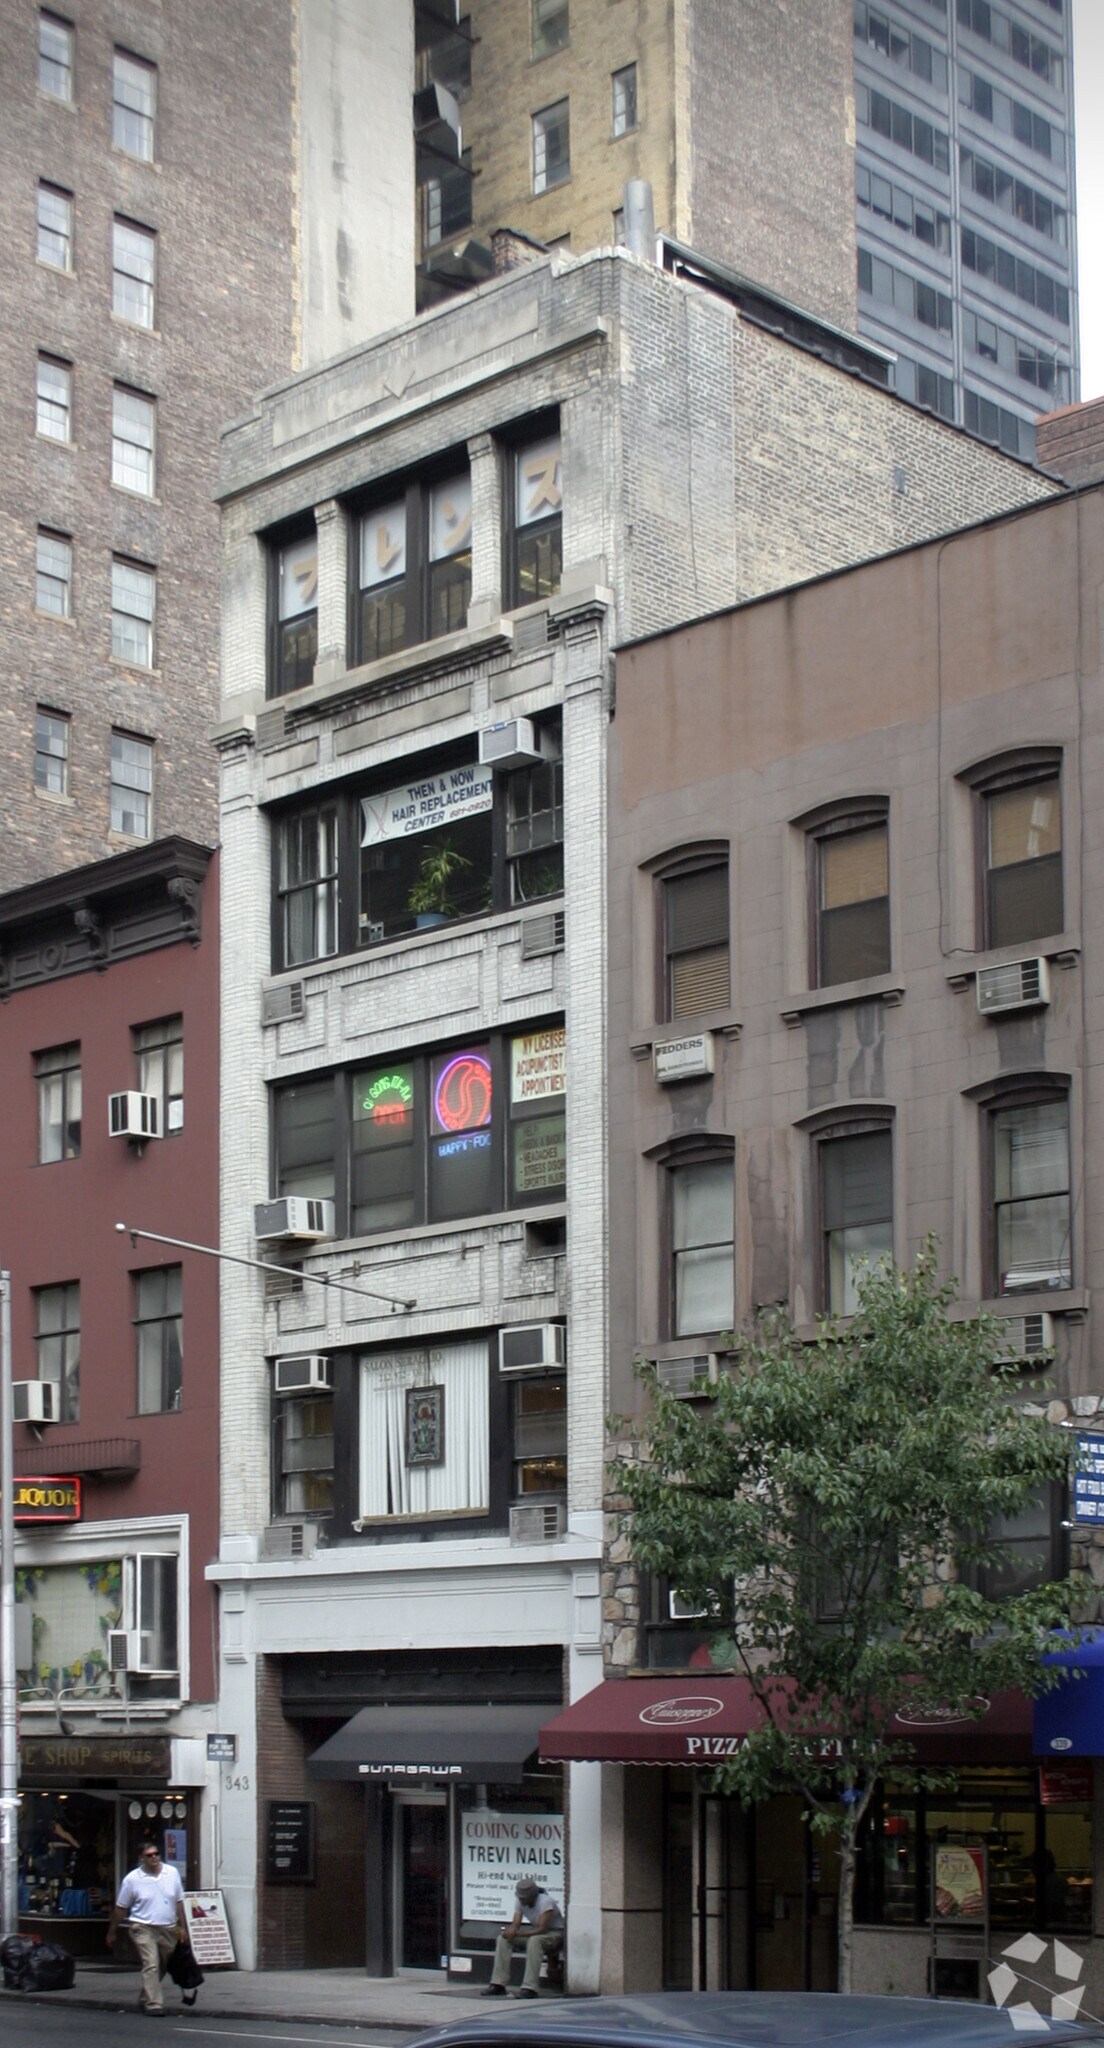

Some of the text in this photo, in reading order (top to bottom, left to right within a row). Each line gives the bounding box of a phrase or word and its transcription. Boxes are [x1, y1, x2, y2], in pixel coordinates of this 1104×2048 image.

[407, 768, 476, 802] THEN & NOW
[391, 780, 493, 823] HAIR REPLACEMENT
[404, 810, 446, 833] CENTER
[656, 1038, 703, 1057] FEDDERS
[373, 1103, 406, 1125] OPEN
[45, 1746, 90, 1766] SHOP
[101, 1750, 151, 1763] SPIRITS
[359, 1764, 462, 1774] SUNAGAWA
[225, 1775, 250, 1791] 343
[466, 1822, 563, 1841] COMING SOON
[468, 1845, 562, 1866] TREVI NAILS
[507, 1872, 523, 1881] Nail
